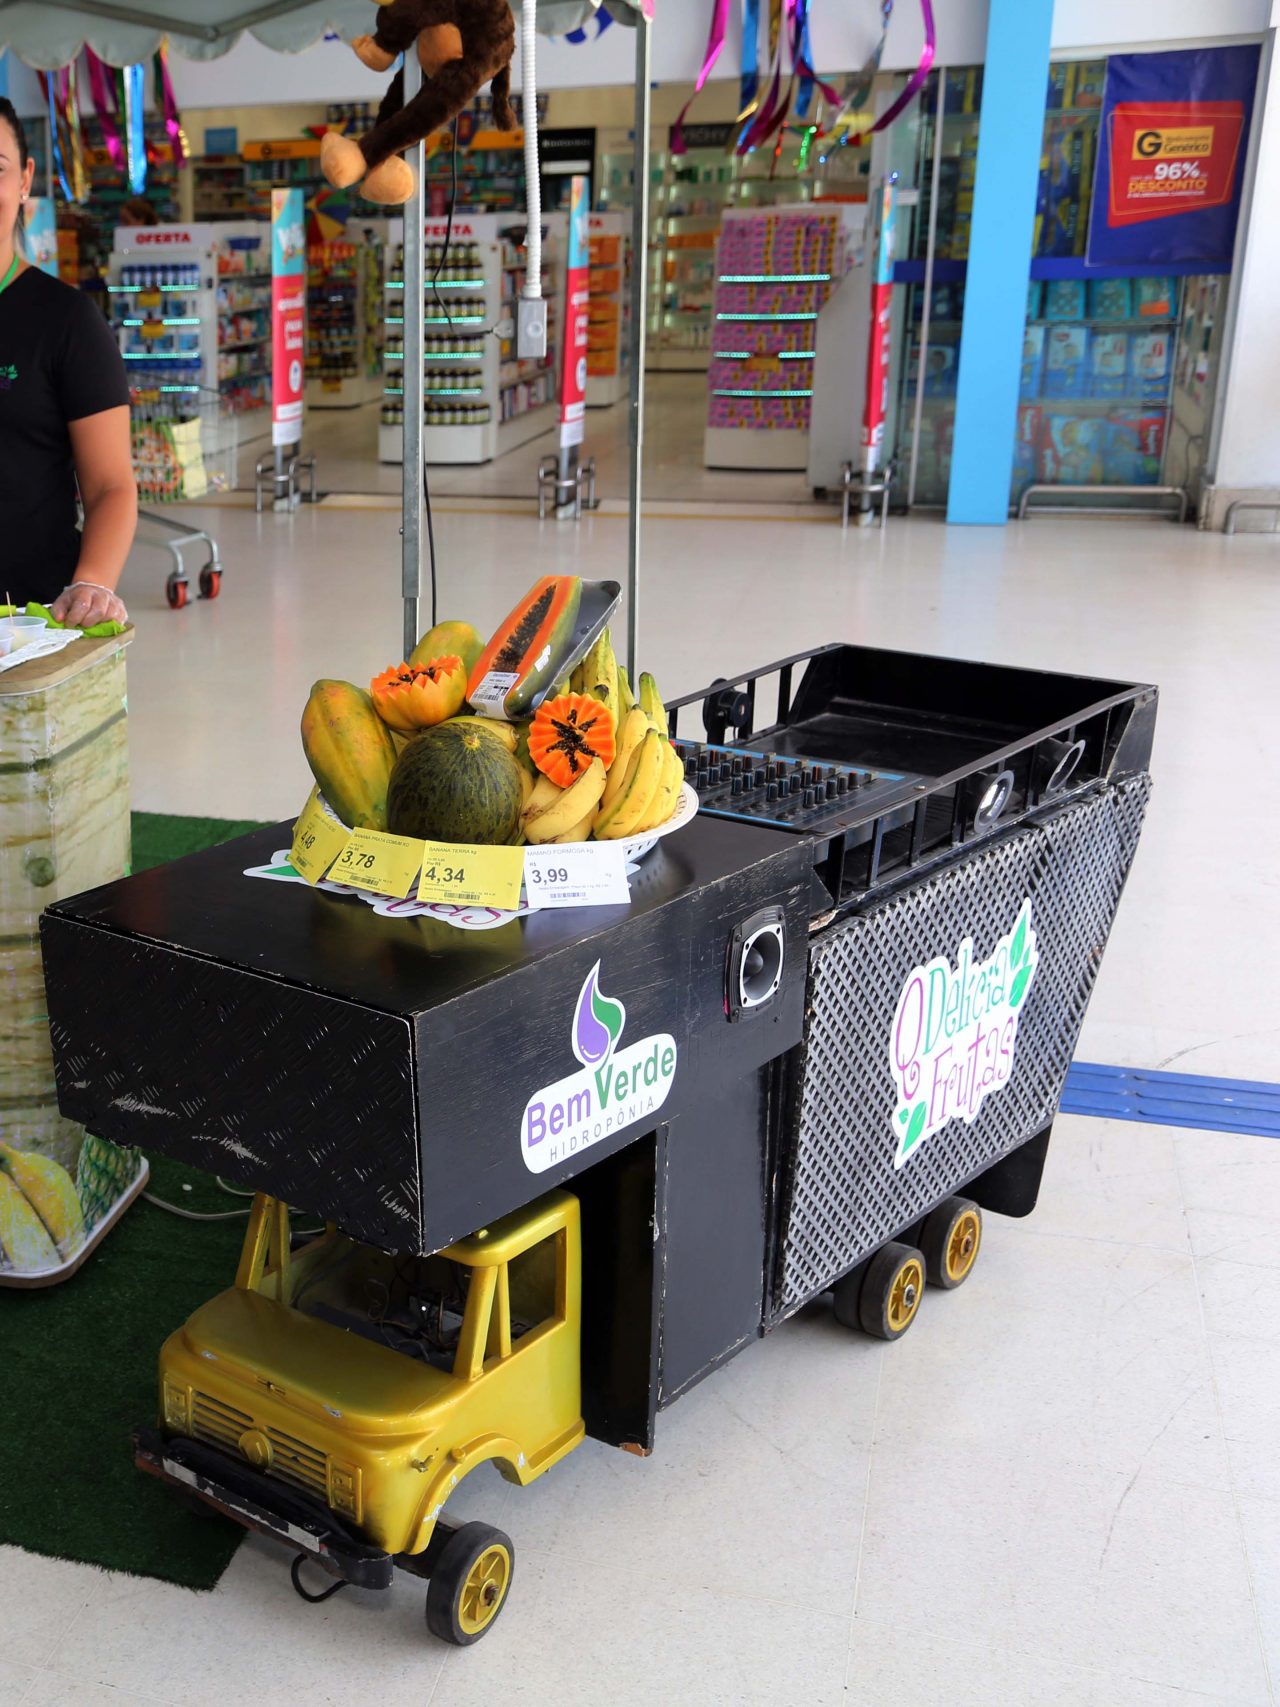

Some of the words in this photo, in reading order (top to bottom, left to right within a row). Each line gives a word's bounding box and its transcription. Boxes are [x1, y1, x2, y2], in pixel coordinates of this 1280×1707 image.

[1136, 131, 1162, 157] G
[1154, 161, 1200, 180] 96%
[1128, 179, 1207, 193] DESCONTO
[135, 231, 192, 245] OFERTA
[341, 850, 375, 869] 3,78
[425, 867, 465, 883] 4,34
[531, 868, 568, 885] 3,99
[926, 1016, 1015, 1129] Frutas
[550, 1096, 655, 1162] HIDROPÔNIA
